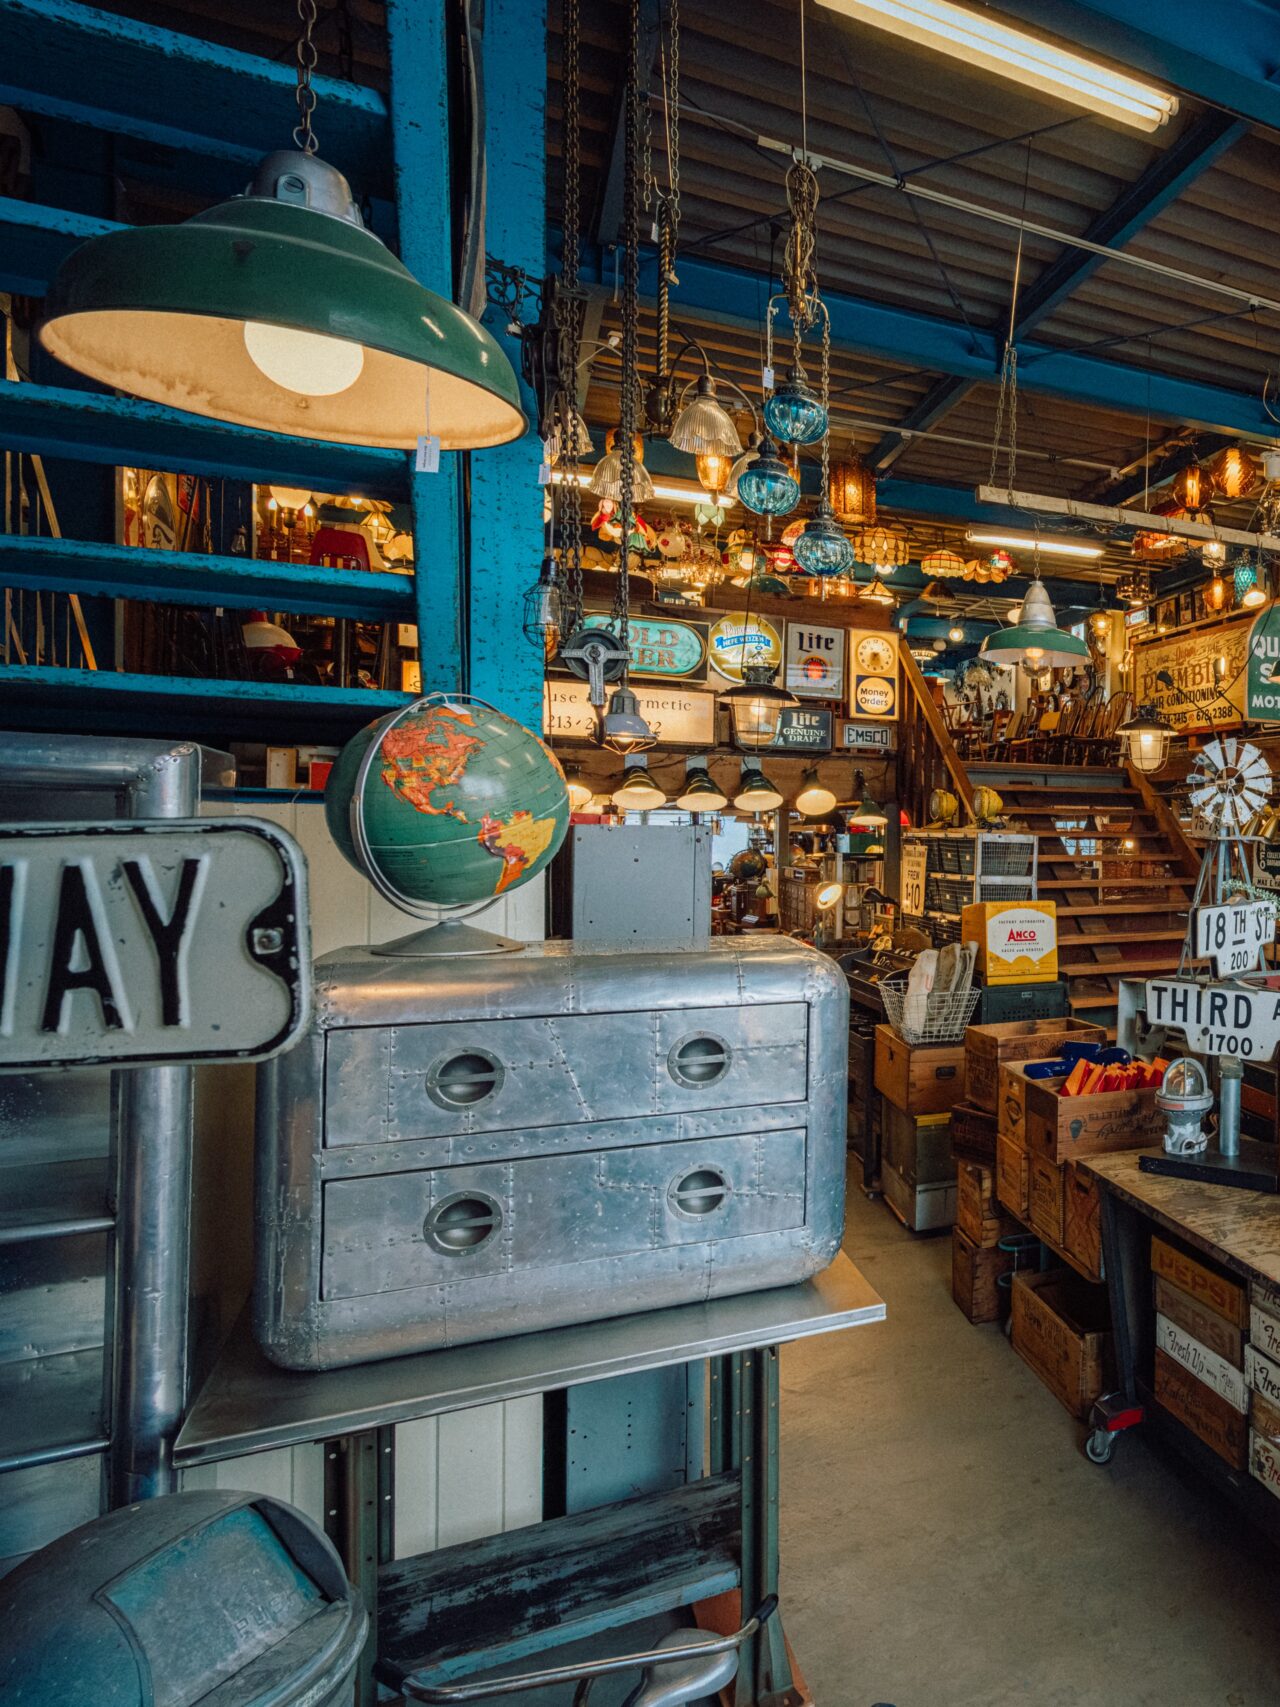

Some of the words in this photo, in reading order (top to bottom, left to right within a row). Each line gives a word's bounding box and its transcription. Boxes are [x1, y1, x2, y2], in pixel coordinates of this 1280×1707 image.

[796, 631, 835, 653] Lite
[860, 687, 889, 698] Money
[860, 696, 889, 707] Orders
[791, 711, 820, 728] Lite
[783, 728, 826, 737] GENUINE
[789, 735, 821, 743] DRAFT
[847, 728, 888, 745] EMSCO
[1007, 928, 1037, 942] ANCO
[1231, 950, 1249, 970] 200
[1151, 986, 1253, 1029] THIRD
[1208, 1034, 1253, 1056] 1700
[1158, 1255, 1236, 1315] PEPSI
[1168, 1329, 1191, 1361] Fresh
